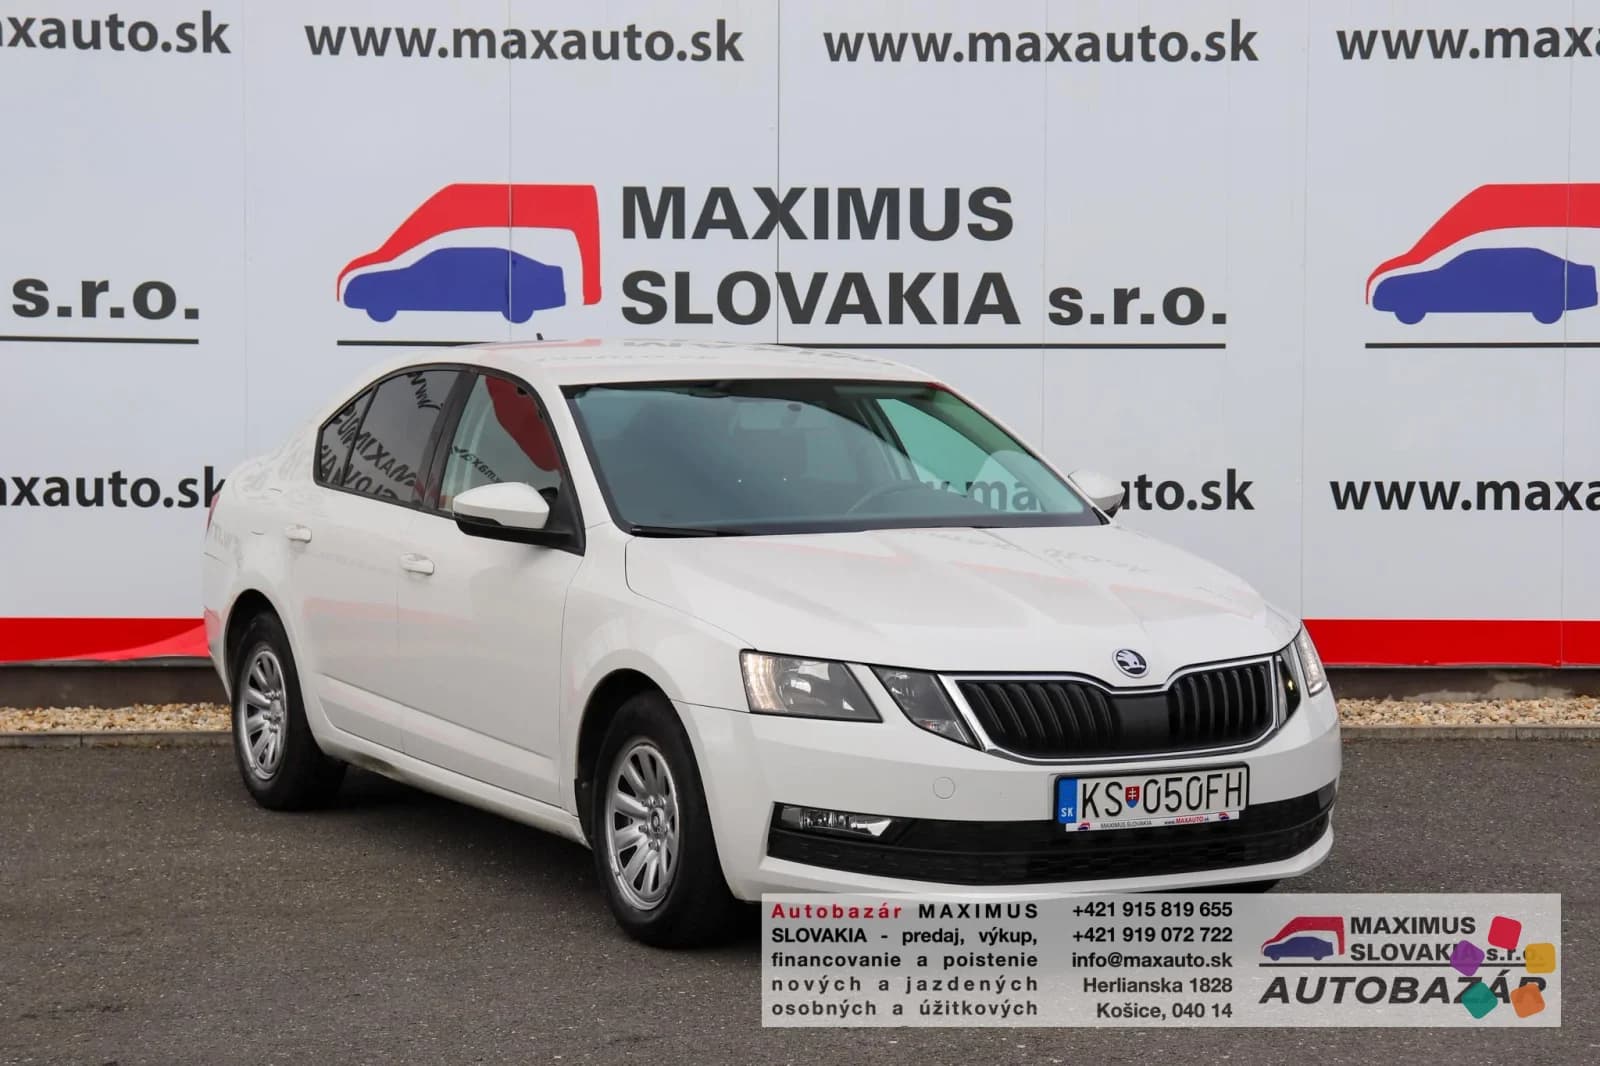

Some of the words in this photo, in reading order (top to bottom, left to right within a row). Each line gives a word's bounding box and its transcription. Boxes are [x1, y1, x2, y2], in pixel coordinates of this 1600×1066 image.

[0, 10, 232, 54] xauto.sk
[304, 19, 745, 62] www.maxauto.sk
[823, 19, 1259, 62] www.maxauto.sk
[1336, 26, 1600, 60] www.max
[622, 186, 1013, 241] MAXIMUS
[12, 278, 199, 320] s.r.o.
[621, 271, 1021, 325] SLOVAKIA
[1048, 286, 1227, 325] s.r.o.
[1060, 807, 1074, 818] SK
[1081, 781, 1123, 819] KS
[1143, 771, 1243, 814] 050FH
